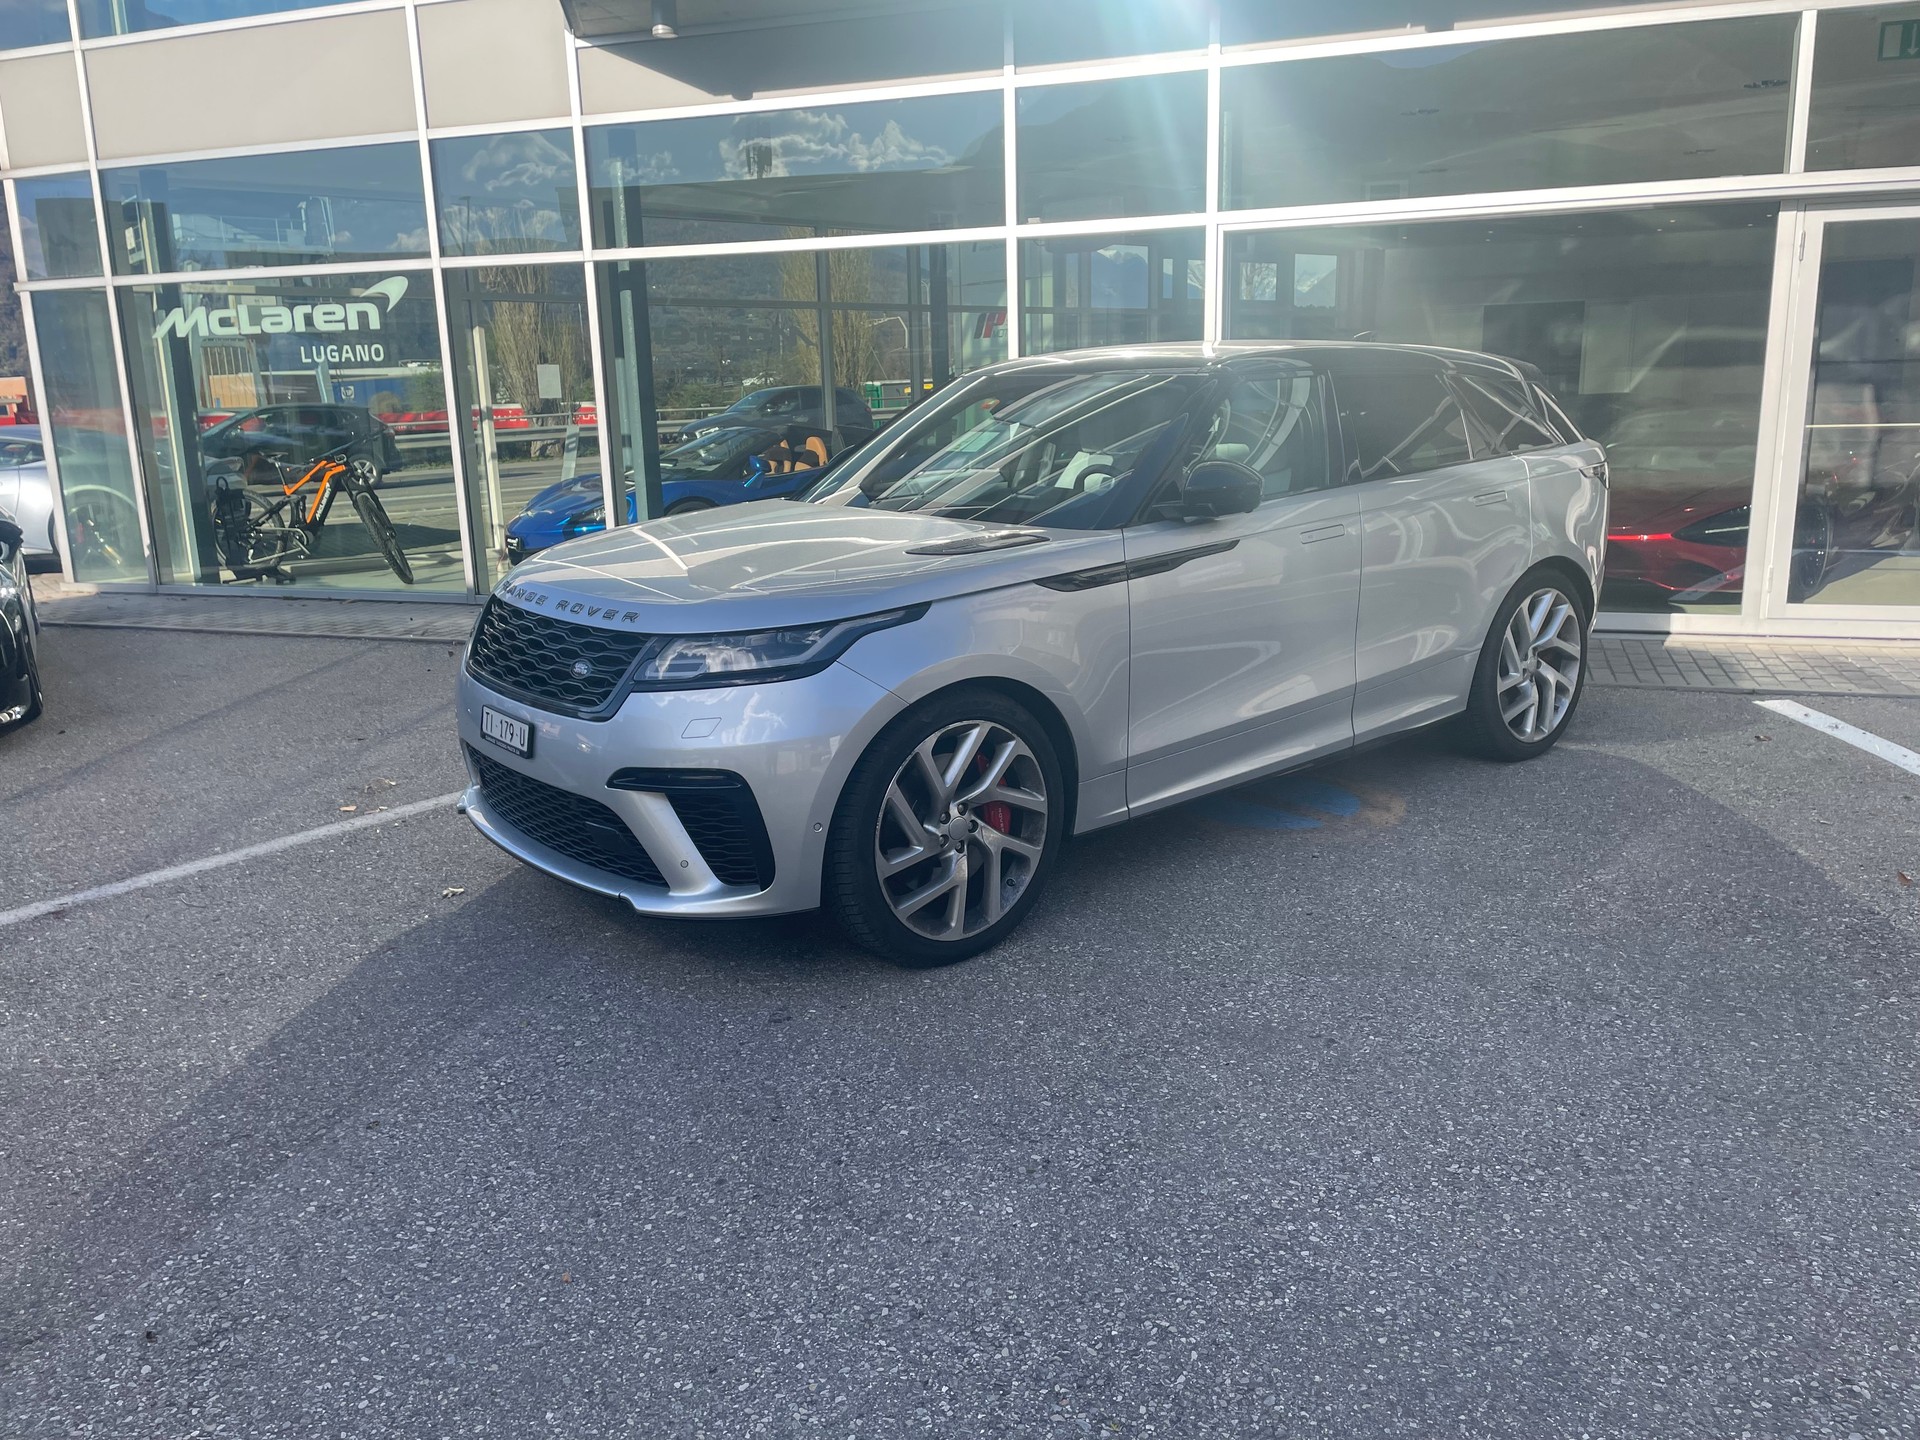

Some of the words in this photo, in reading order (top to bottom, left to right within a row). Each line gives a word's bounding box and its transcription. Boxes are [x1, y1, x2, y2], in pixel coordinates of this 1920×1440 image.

[152, 302, 381, 339] McLaren
[300, 343, 385, 363] LUGANO
[502, 580, 548, 606] RANGE
[555, 599, 639, 623] ROVER
